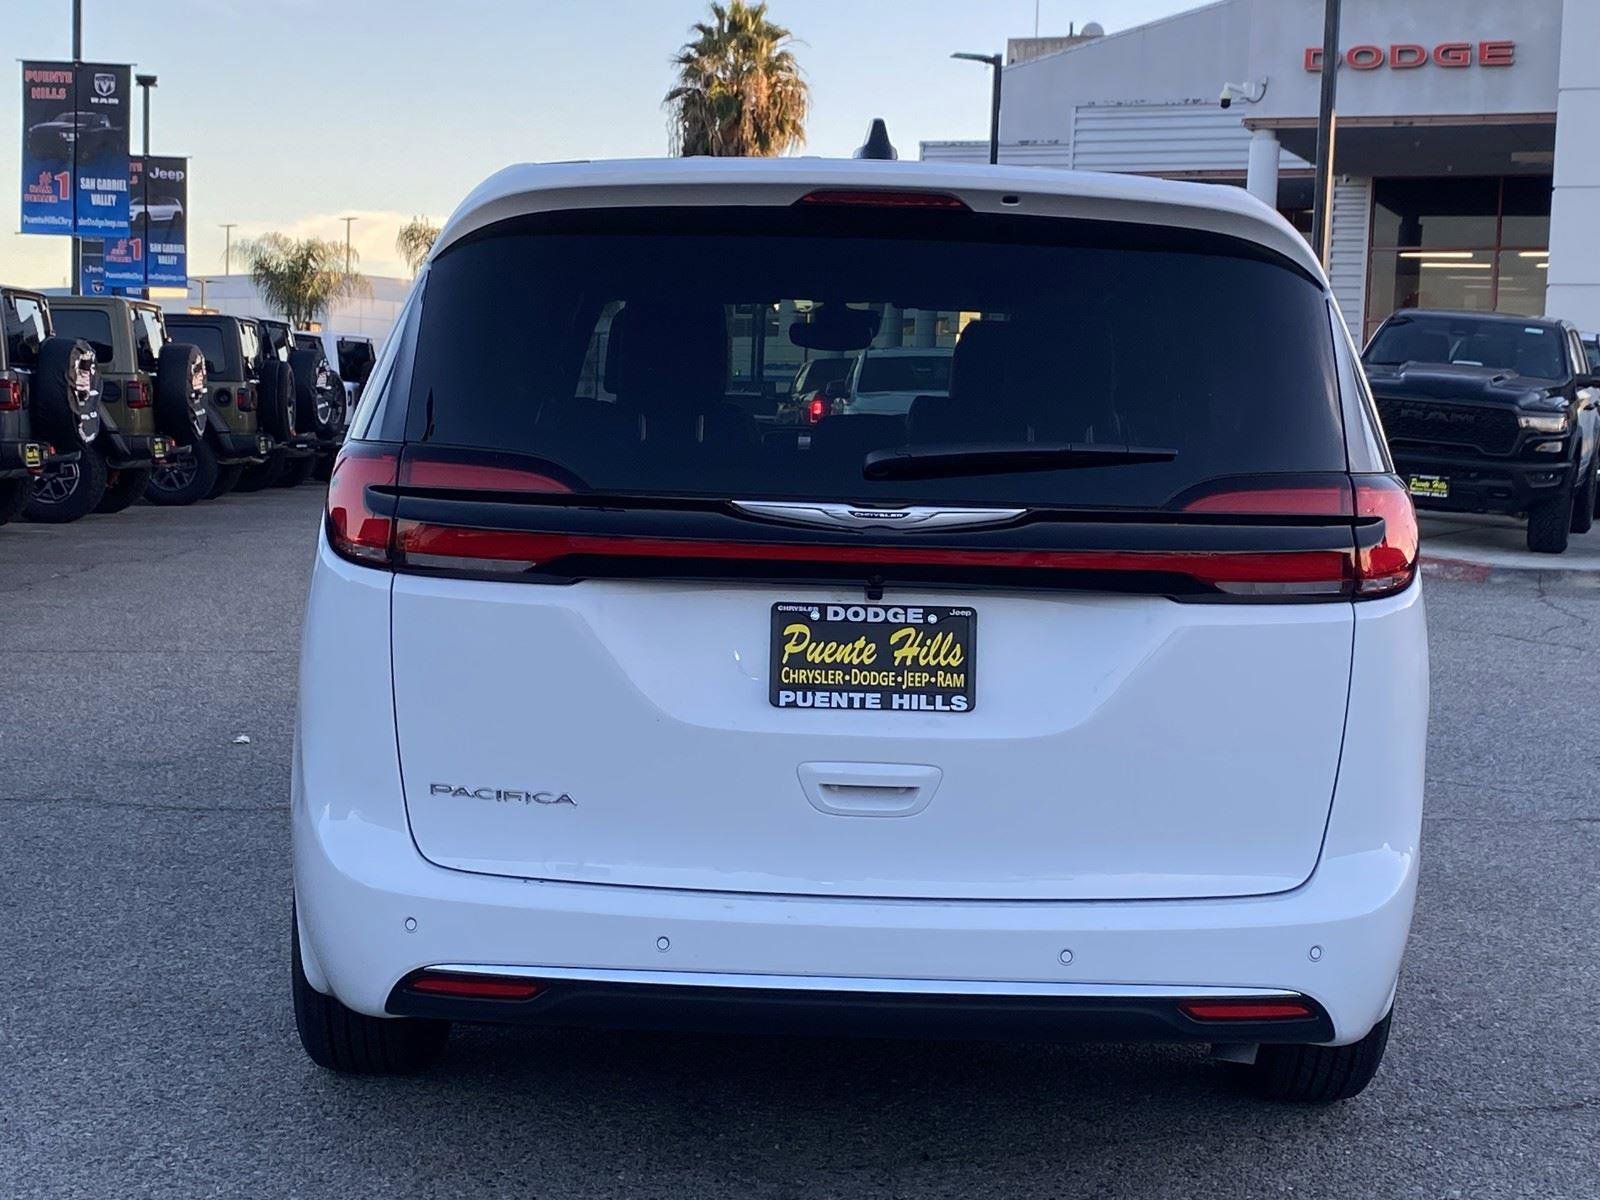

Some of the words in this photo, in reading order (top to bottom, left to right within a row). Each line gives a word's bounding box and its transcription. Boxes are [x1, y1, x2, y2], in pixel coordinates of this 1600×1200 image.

[1304, 40, 1516, 72] DODGE
[25, 70, 73, 83] PUENTE
[31, 87, 66, 99] HILLS
[149, 167, 185, 182] Jeep
[80, 177, 95, 190] SAN
[97, 178, 127, 191] GABRIEL
[91, 194, 117, 206] VALLEY
[85, 265, 104, 273] Jee
[826, 606, 924, 624] DODGE
[949, 609, 972, 617] Jeep
[782, 623, 877, 665] Puente
[889, 627, 964, 667] Hills
[779, 690, 882, 709] PUENTE
[892, 693, 969, 711] HILLS
[430, 783, 578, 807] PACIFICA
